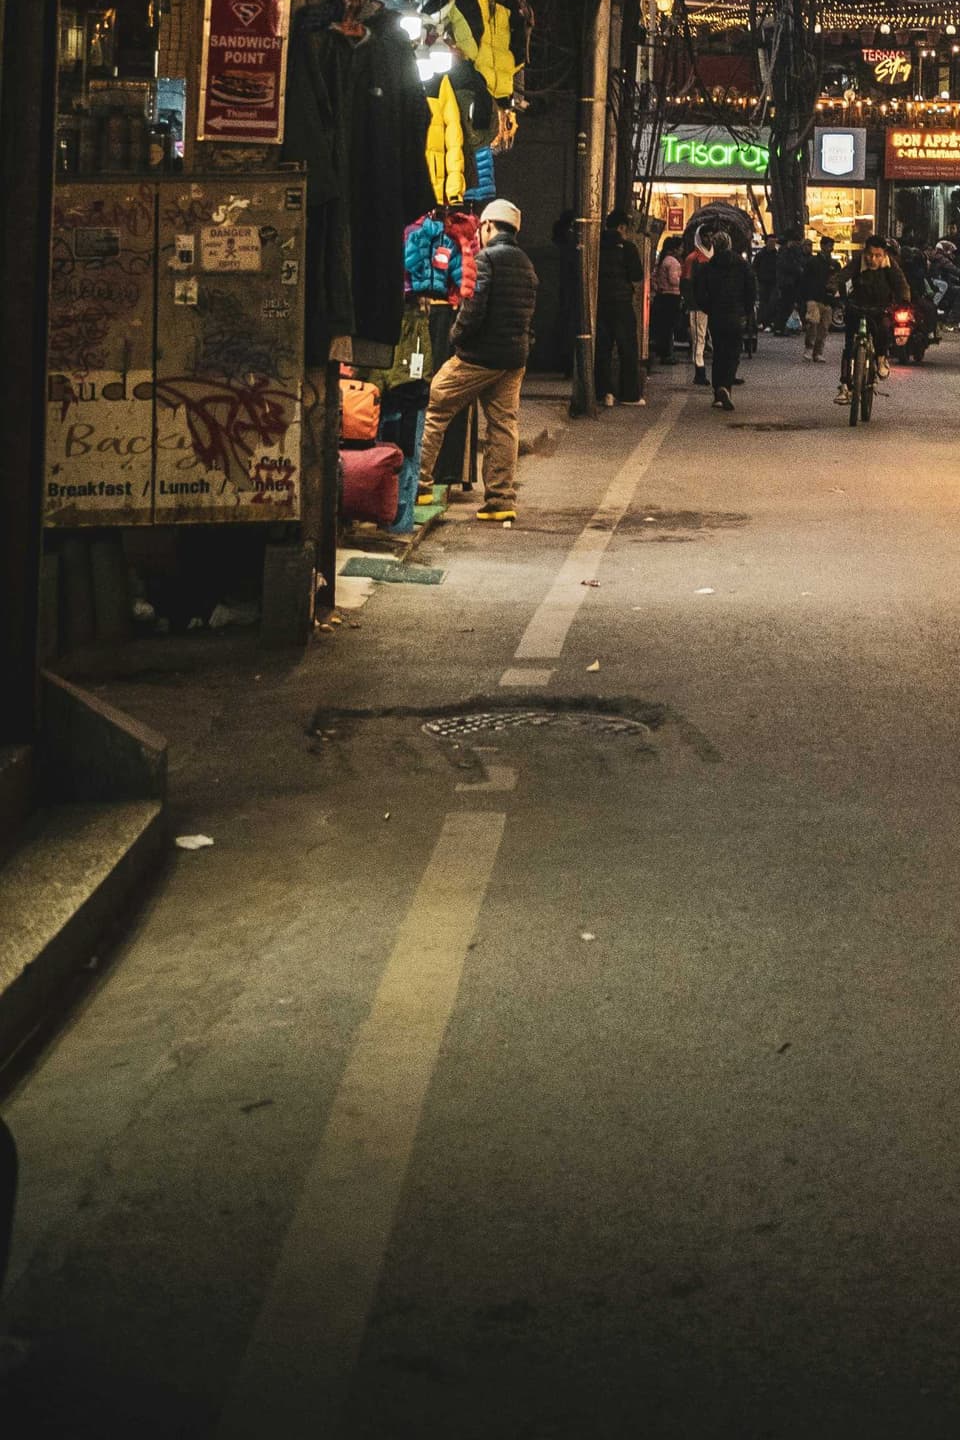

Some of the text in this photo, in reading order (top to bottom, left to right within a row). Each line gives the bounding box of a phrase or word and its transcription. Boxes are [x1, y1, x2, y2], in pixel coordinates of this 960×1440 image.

[210, 34, 281, 49] SANDWICH
[224, 51, 265, 64] POINT
[893, 132, 921, 146] BON
[210, 228, 251, 237] DANGER
[48, 480, 131, 496] Breakfast
[159, 478, 210, 494] Lunch
